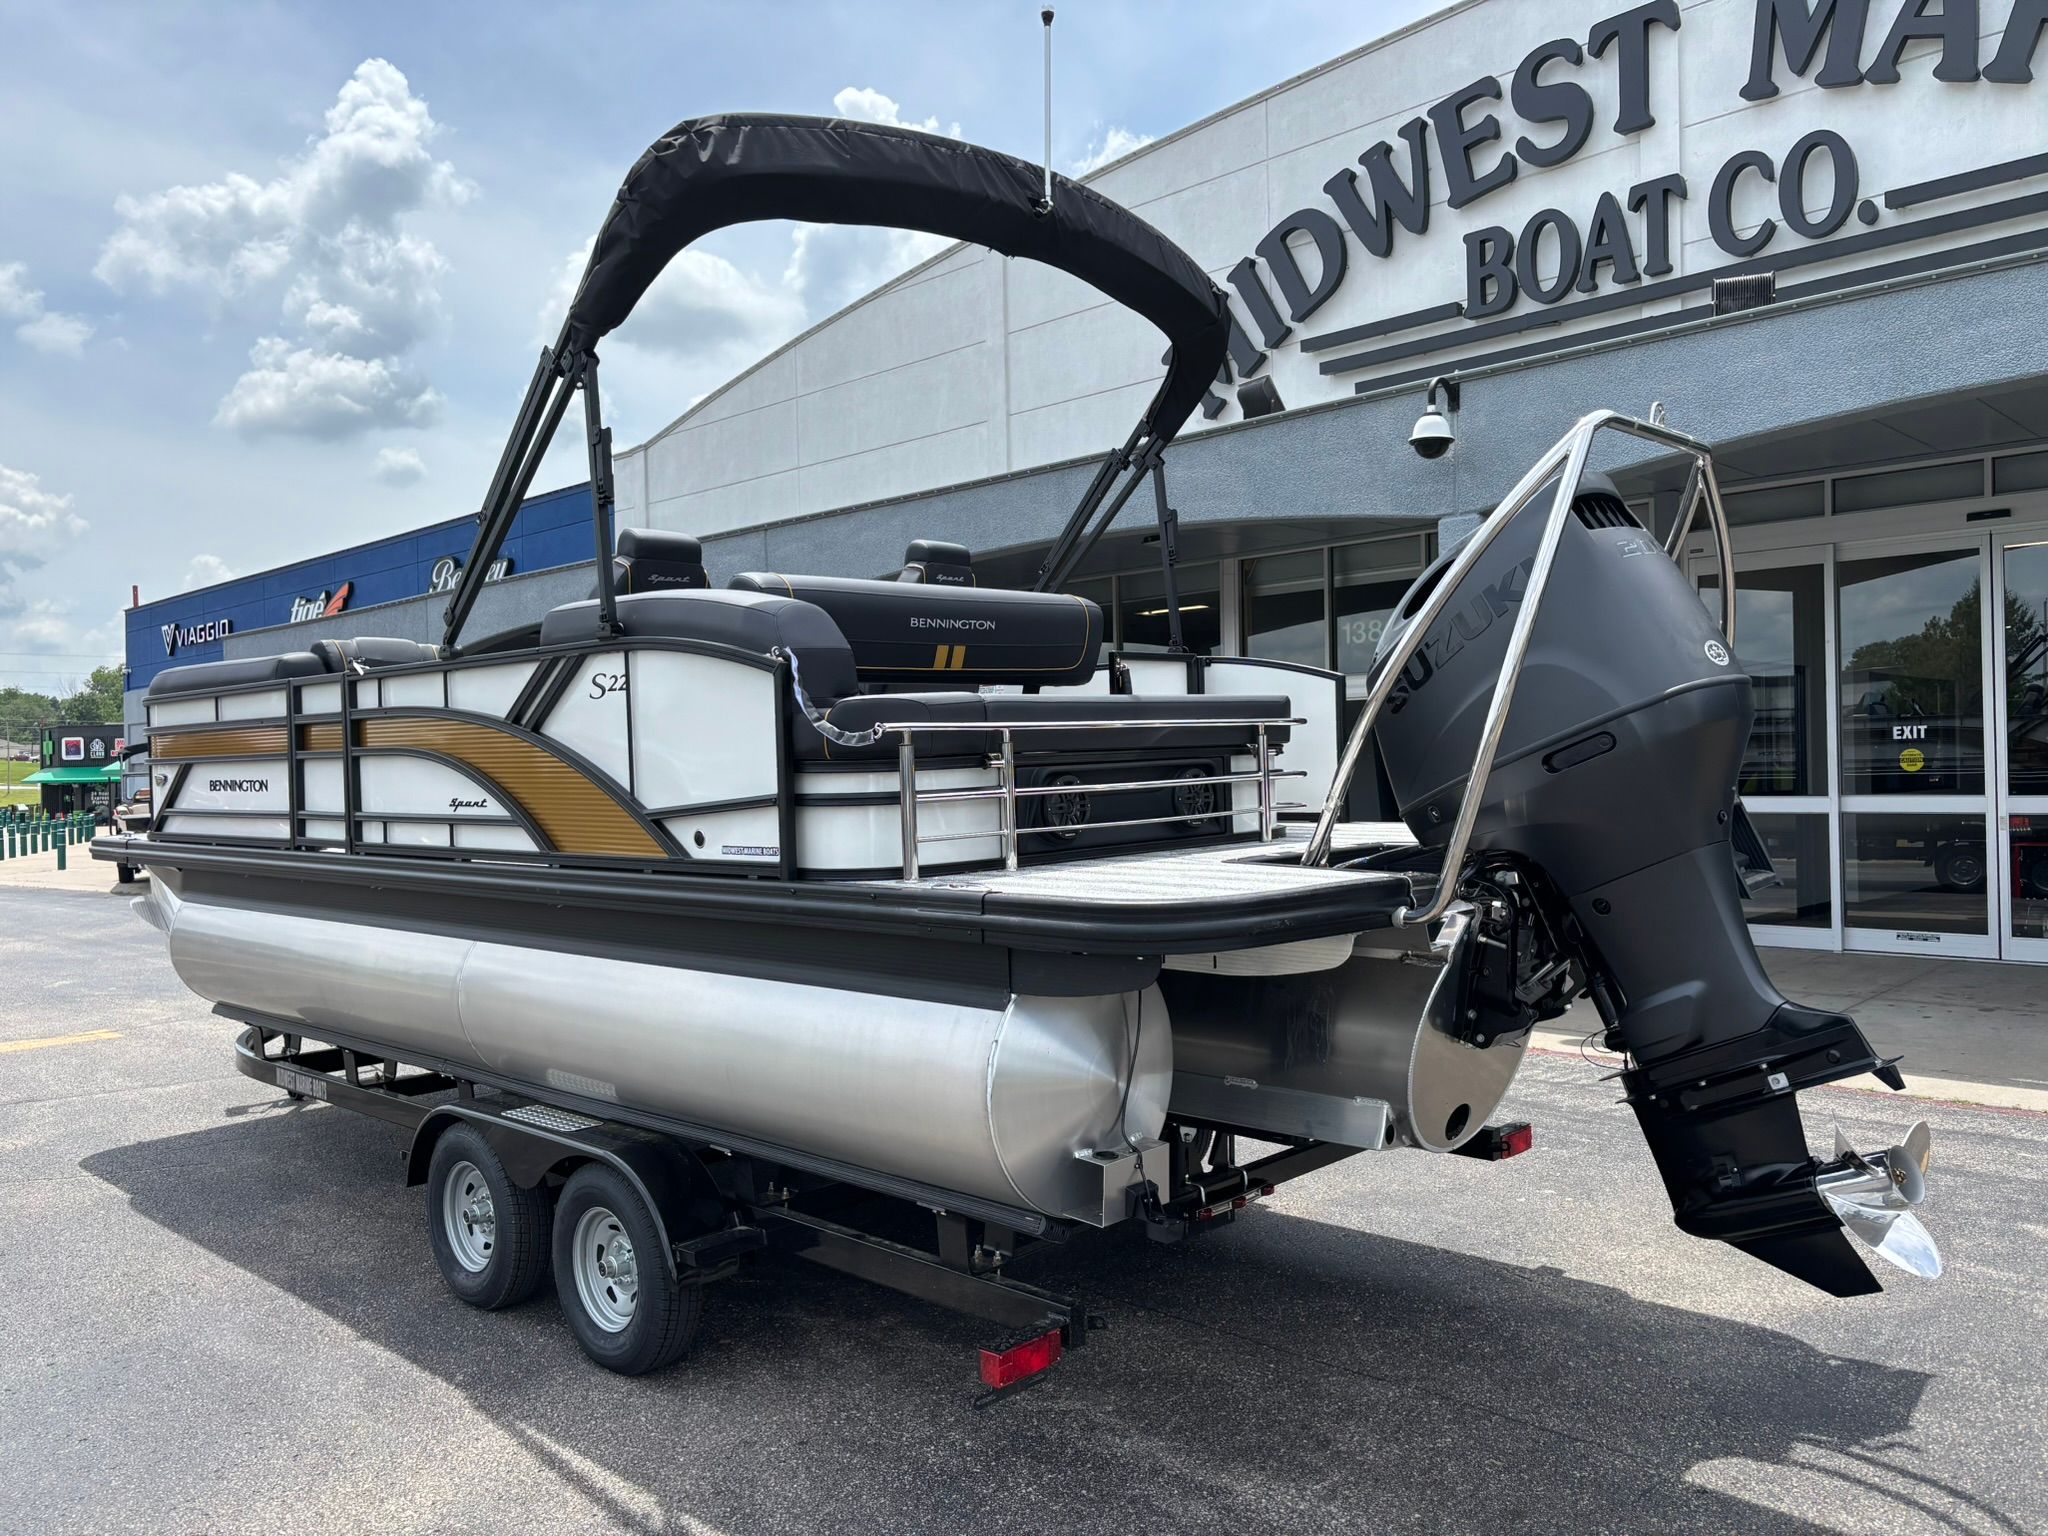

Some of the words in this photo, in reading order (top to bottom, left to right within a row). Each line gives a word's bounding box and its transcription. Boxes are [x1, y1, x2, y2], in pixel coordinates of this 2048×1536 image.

[1739, 0, 2048, 101] MA
[1463, 173, 1688, 319] BOAT
[1709, 129, 1880, 257] CO.
[430, 558, 508, 592] Beey
[175, 619, 229, 648] VIAGGIO
[909, 617, 997, 630] BENNINGTON
[1892, 725, 1928, 740] EXIT
[209, 779, 268, 793] BENNINGTON
